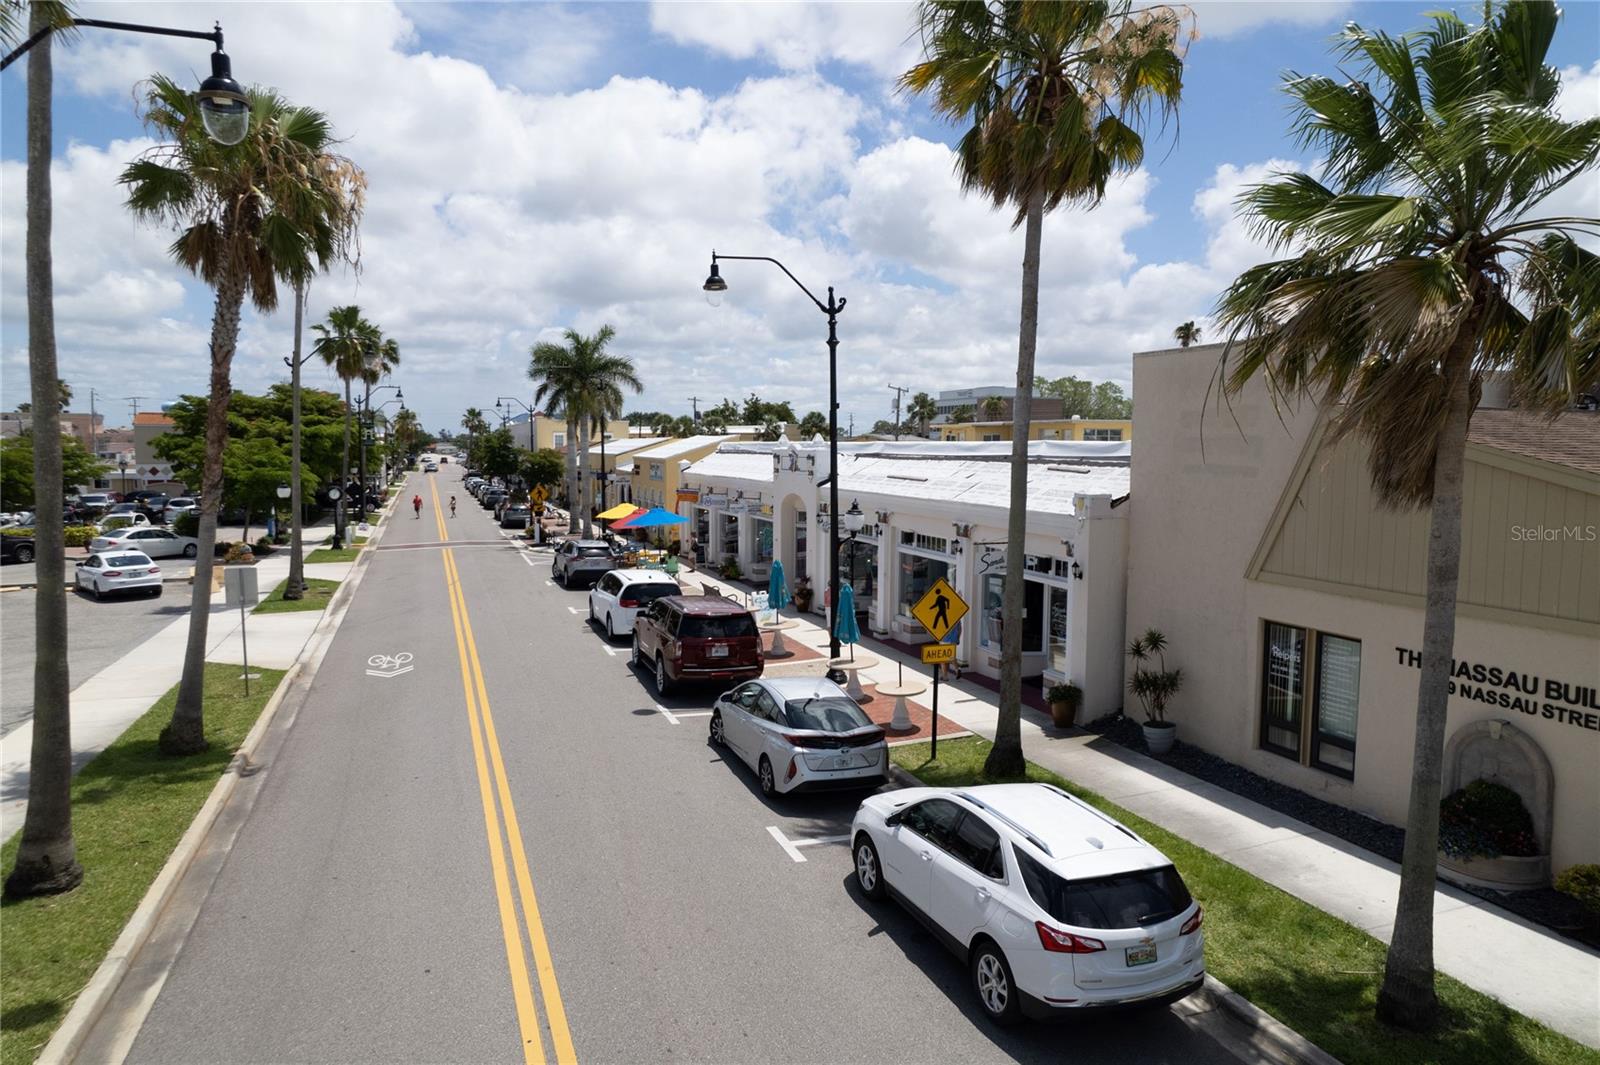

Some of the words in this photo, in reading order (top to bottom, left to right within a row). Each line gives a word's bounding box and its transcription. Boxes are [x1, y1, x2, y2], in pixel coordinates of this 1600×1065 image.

[926, 648, 953, 659] AHEAD
[1395, 647, 1422, 669] TH
[1460, 683, 1538, 715] NASSAU
[1541, 703, 1600, 732] STRE
